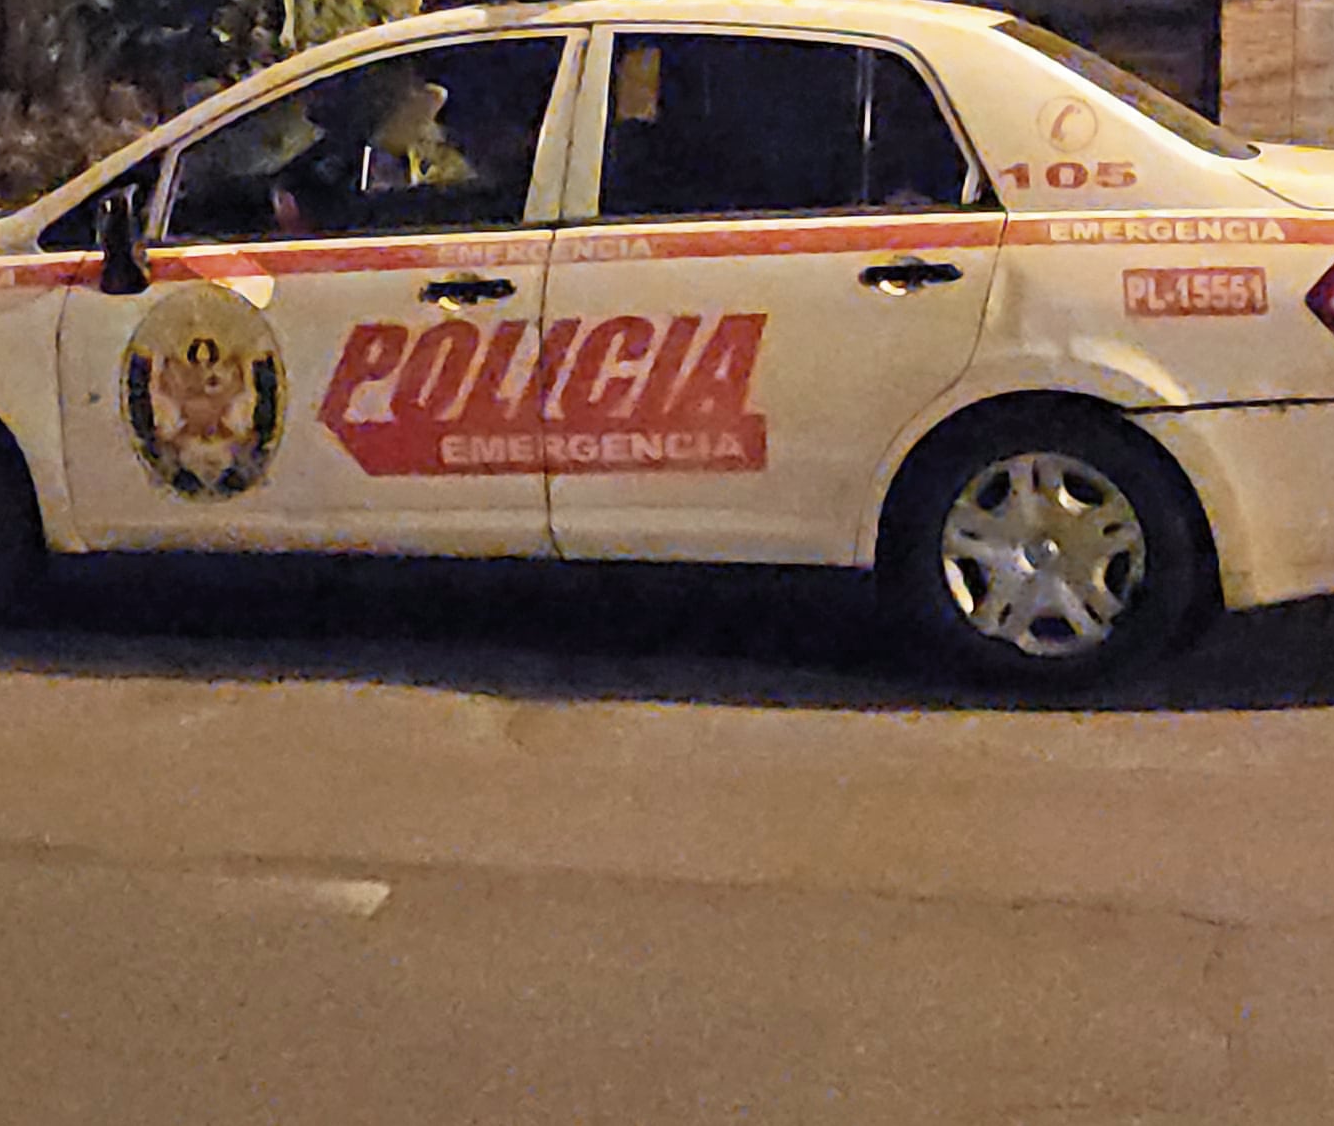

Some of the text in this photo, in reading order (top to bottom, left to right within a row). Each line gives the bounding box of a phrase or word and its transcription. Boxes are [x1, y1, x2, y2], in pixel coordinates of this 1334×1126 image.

[1000, 160, 1137, 190] 105
[1049, 219, 1286, 243] EMERGENCIA
[317, 312, 768, 425] POLICIA
[439, 431, 747, 465] EMERGENCIA
